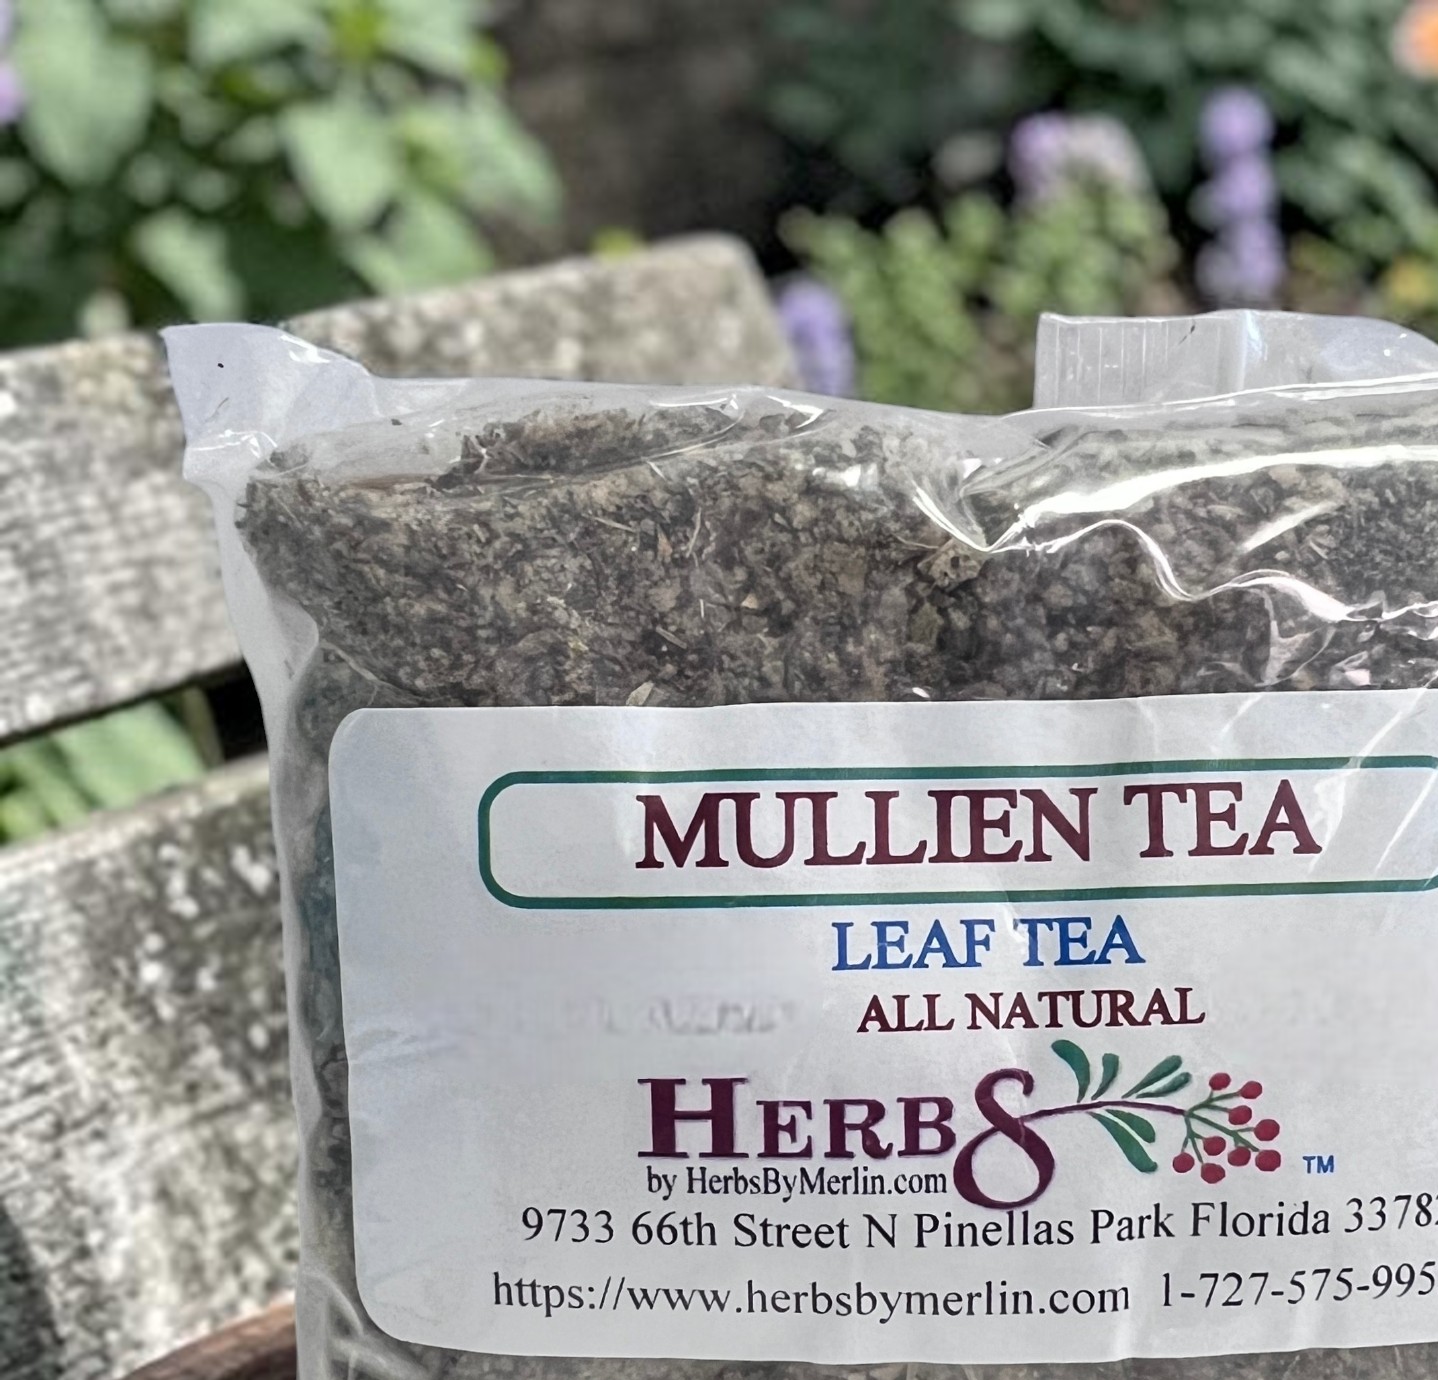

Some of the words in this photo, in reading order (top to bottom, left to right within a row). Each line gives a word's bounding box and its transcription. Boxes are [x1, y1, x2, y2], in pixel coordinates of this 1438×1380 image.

[635, 787, 1098, 869] MULLIEN
[1123, 779, 1323, 859] TEA
[831, 918, 996, 972] LEAF
[1011, 914, 1147, 968] TEA
[856, 992, 956, 1034] ALL
[964, 986, 1207, 1031] NATURAL
[646, 1164, 678, 1202] by
[686, 1164, 949, 1204] HerbsByMerlin.com
[1301, 1154, 1336, 1175] TM
[521, 1206, 615, 1244] 9733
[631, 1210, 718, 1247] 66th
[733, 1212, 851, 1250] Street
[862, 1213, 898, 1249] N
[913, 1209, 1075, 1249] Pinellas
[1089, 1202, 1176, 1245] Park
[1189, 1200, 1331, 1238] Florida
[492, 1271, 1131, 1325] https://www.herbsbymerlin.com
